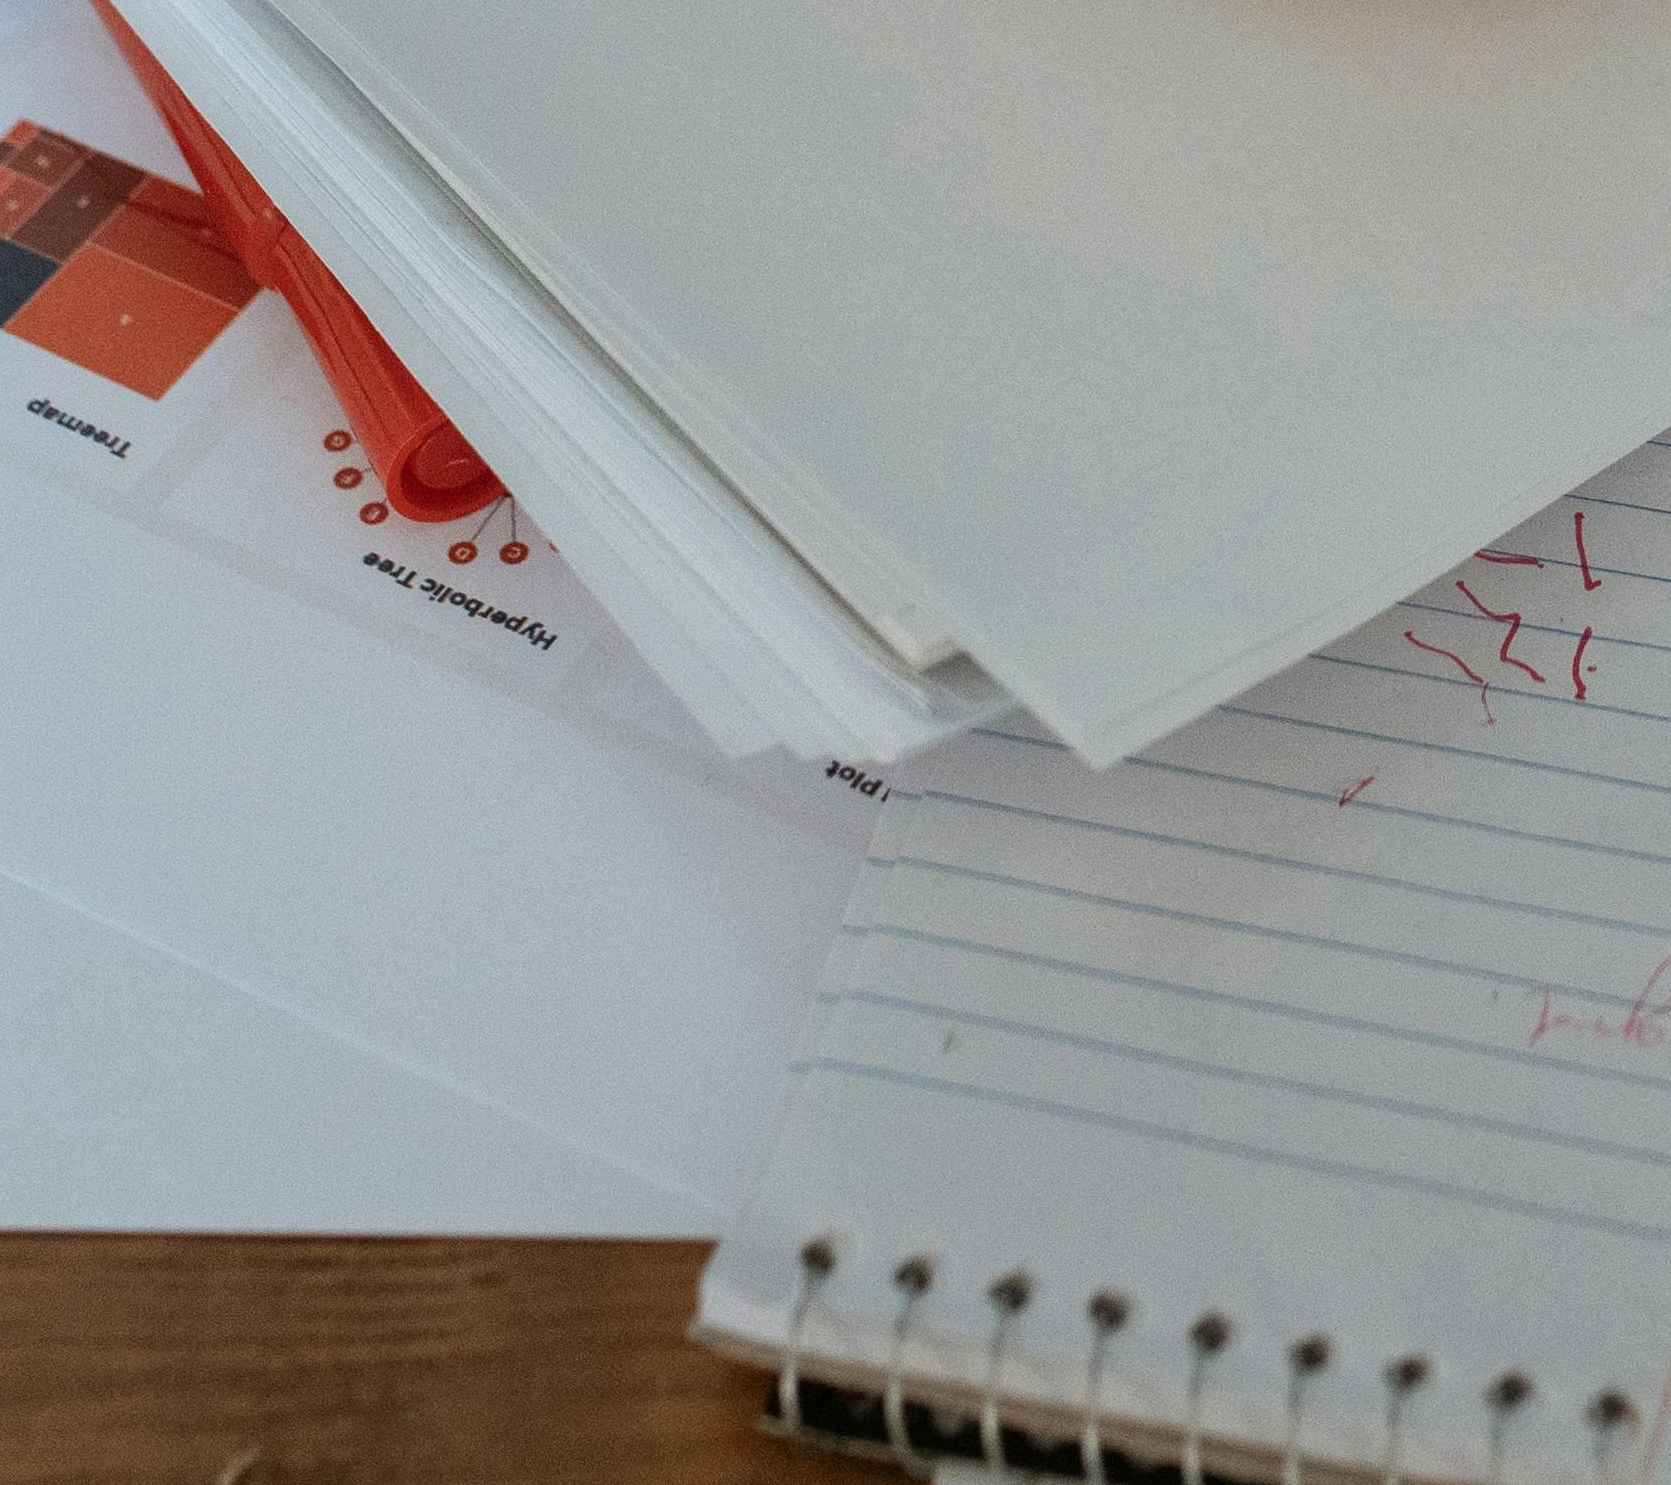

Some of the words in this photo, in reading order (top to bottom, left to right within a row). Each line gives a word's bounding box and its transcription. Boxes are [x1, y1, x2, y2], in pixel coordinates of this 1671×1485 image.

[24, 397, 137, 465] Treemap
[361, 551, 418, 590] Tree
[420, 578, 559, 652] Hyperbolic
[824, 759, 884, 799] Plot
